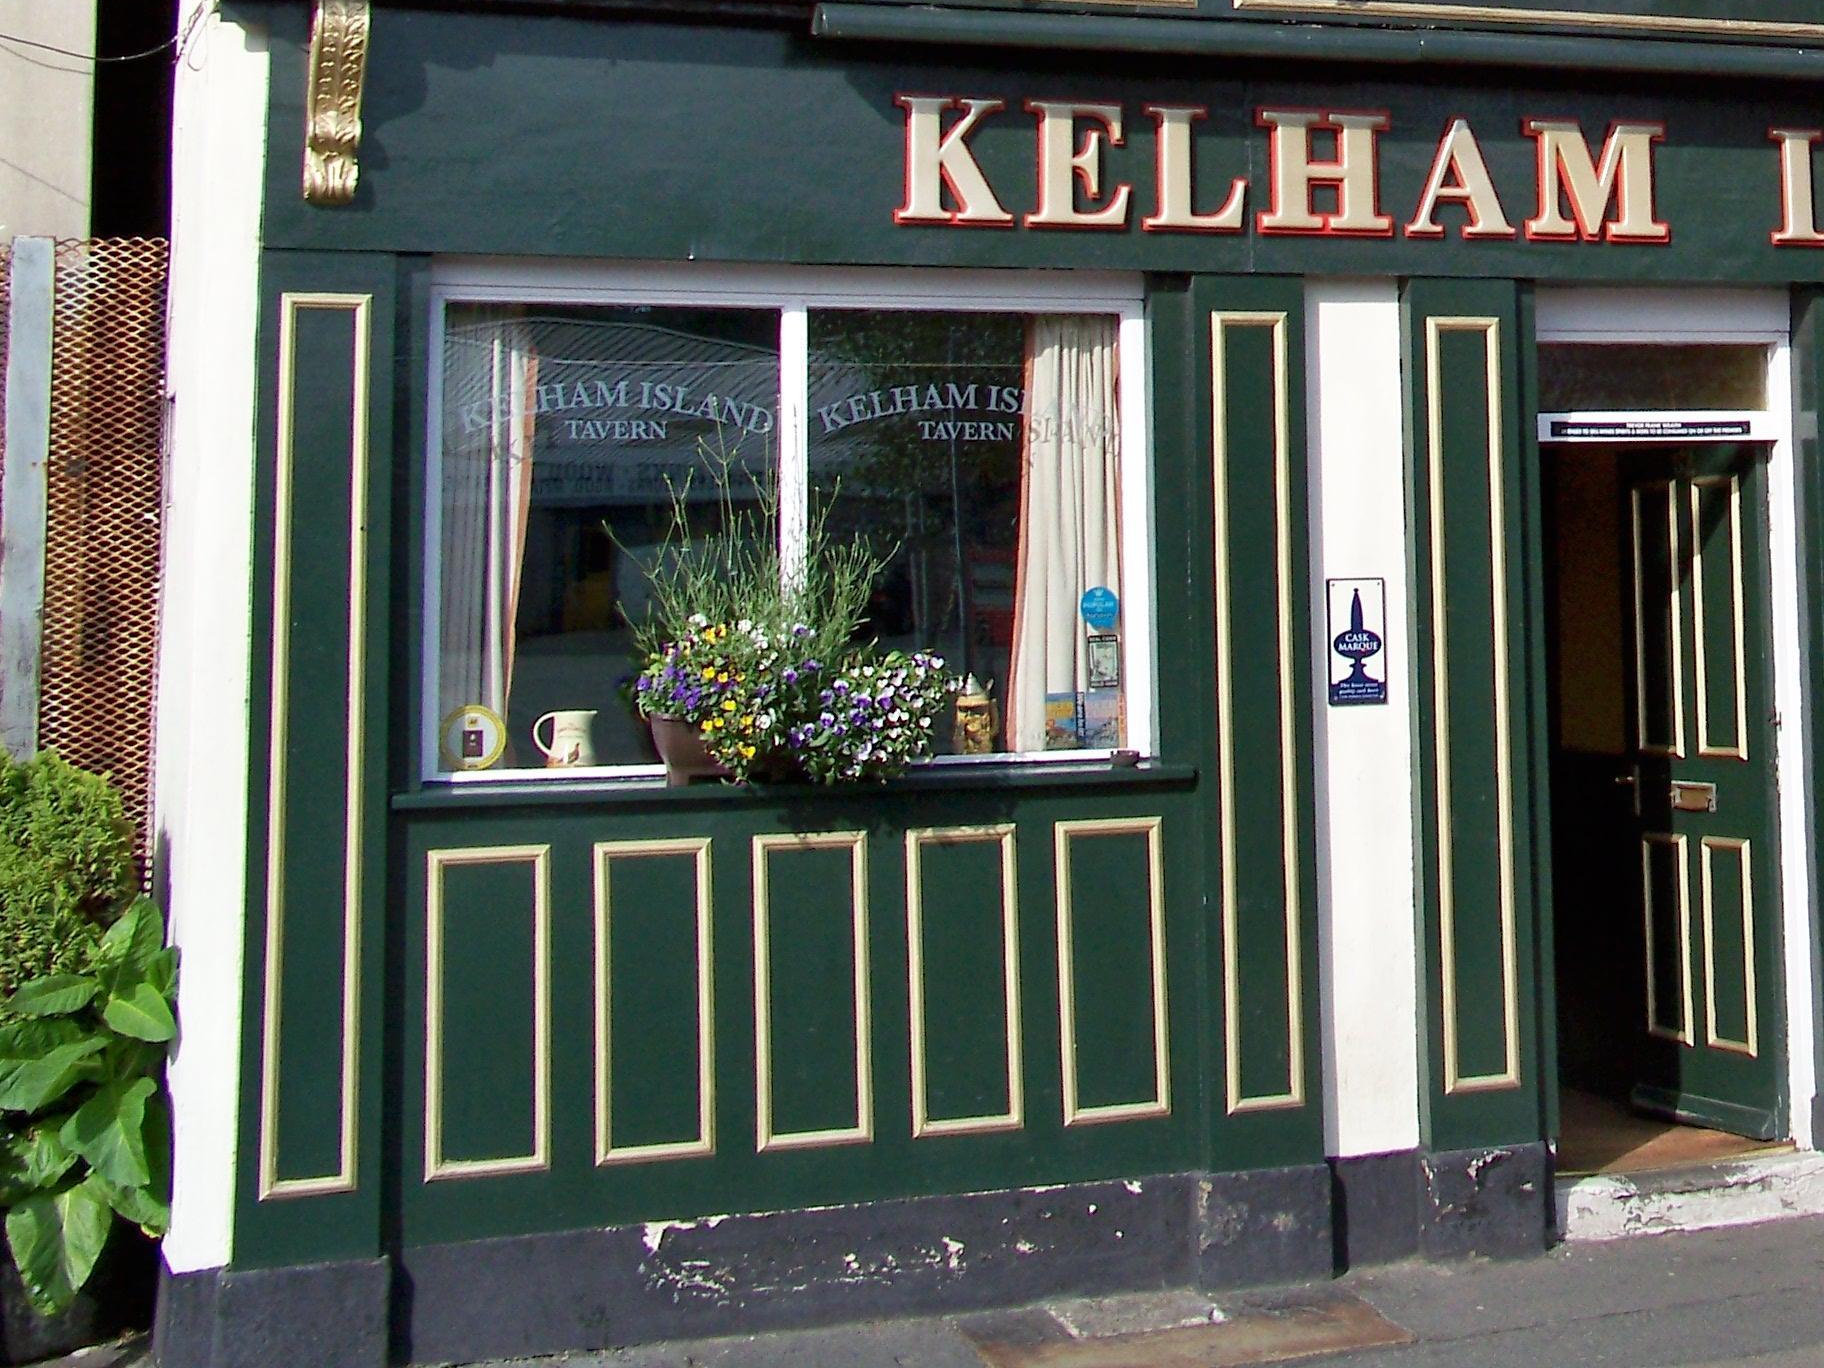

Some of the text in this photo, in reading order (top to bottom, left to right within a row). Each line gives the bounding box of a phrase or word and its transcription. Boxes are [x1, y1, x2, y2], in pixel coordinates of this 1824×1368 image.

[892, 91, 1673, 248] KELHAM
[638, 382, 775, 434] ISLAND
[816, 383, 979, 434] KELHAM
[564, 419, 668, 440] TAVERN
[917, 420, 1015, 442] TAVERN
[1338, 642, 1379, 652] MARQUE
[1344, 633, 1370, 642] CASK
